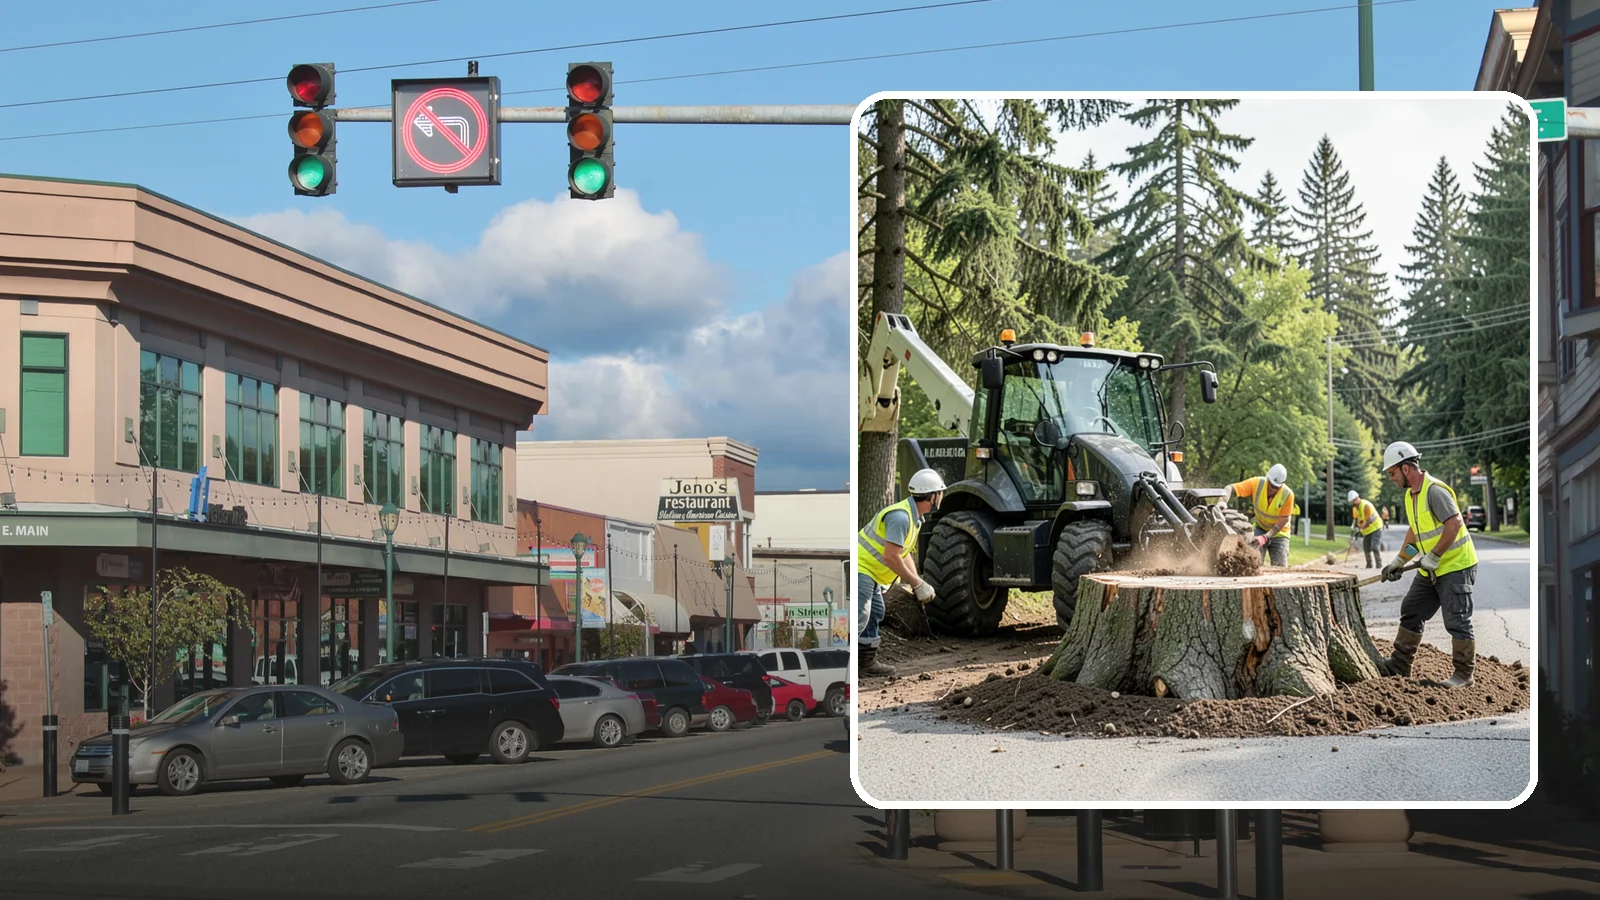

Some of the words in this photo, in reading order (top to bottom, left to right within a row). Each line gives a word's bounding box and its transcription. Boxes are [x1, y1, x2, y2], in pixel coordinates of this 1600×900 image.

[670, 480, 727, 494] Jeno's
[665, 496, 731, 509] restaurant
[686, 509, 714, 519] American
[715, 509, 738, 519] Cuisine
[2, 525, 13, 536] E.
[15, 525, 49, 536] MAIN
[797, 608, 829, 617] Street
